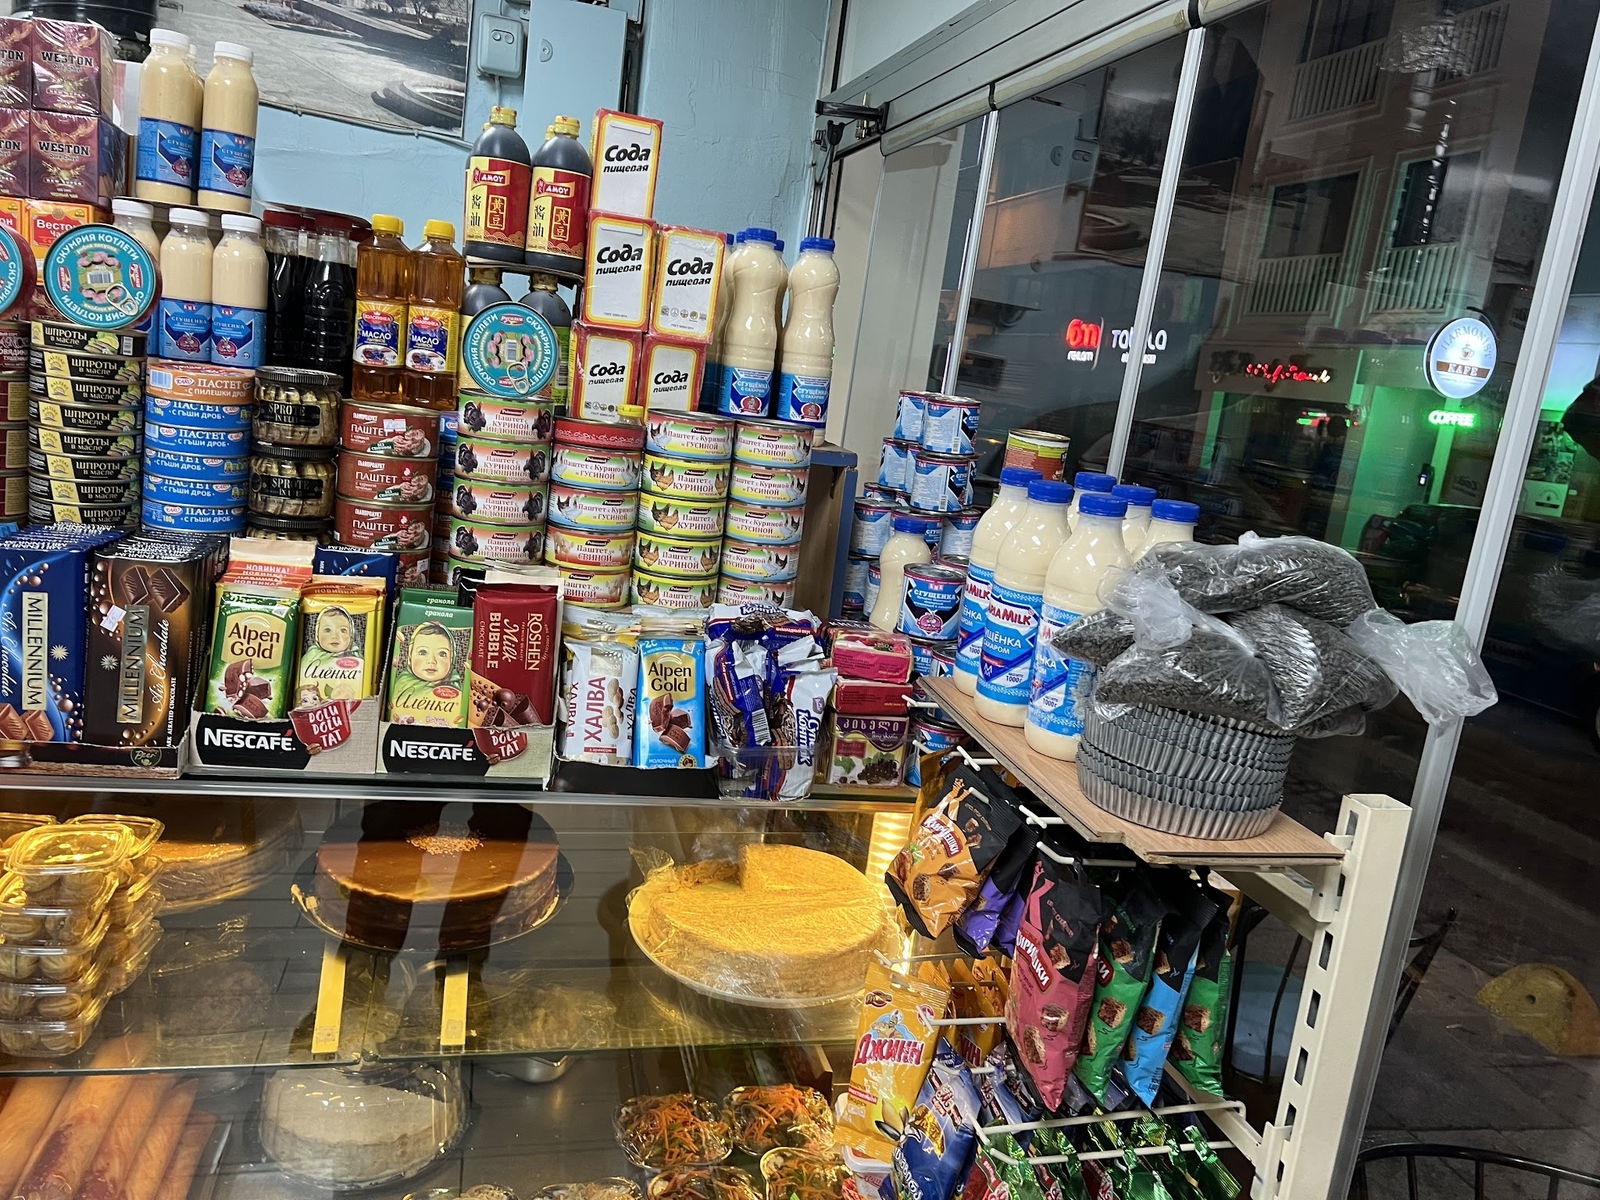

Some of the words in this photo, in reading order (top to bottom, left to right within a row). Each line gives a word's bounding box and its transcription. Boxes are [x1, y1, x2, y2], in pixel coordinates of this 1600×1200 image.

[41, 51, 94, 68] WESTON
[38, 140, 90, 157] WESTON
[604, 143, 652, 162] Сода
[603, 164, 650, 173] пищевая
[480, 173, 504, 184] AMOY
[545, 186, 570, 195] AMOY
[56, 234, 96, 265] СКУМРИЯ
[98, 234, 140, 261] КОТЛЕТИ
[596, 244, 644, 264] Сода
[595, 264, 643, 276] пищевая
[667, 257, 715, 277] Сода
[665, 278, 712, 288] пищевая
[60, 294, 103, 322] КОТЛЕТИ
[45, 327, 87, 341] ШПРОТЫ
[361, 330, 392, 341] МАСЛО
[472, 313, 499, 347] КОТЛЕТИ
[526, 316, 551, 354] СКУМРИЯ
[56, 337, 80, 345] масле
[411, 335, 440, 346] МАСЛО
[71, 358, 117, 370] ШПРОТЫ
[471, 350, 496, 386] СКУМРИЯ
[528, 354, 551, 387] КОТЛЕТ
[589, 362, 626, 377] Сода
[1447, 363, 1479, 377] KAFE
[85, 367, 112, 375] масле
[654, 370, 689, 385] Сода
[75, 383, 121, 395] ШПРОТЫ
[197, 378, 242, 390] ПАСТЕТ
[194, 389, 232, 398] ПИЛЕШКИ
[64, 409, 111, 421] ШПРОТЫ
[200, 412, 223, 420] ДРОБ
[268, 402, 306, 417] SPROTE
[78, 418, 104, 426] масле
[492, 420, 530, 429] КУРИНОЙ
[1429, 410, 1476, 427] COFFEE
[64, 435, 110, 446] ШПРОТЫ
[179, 429, 227, 440] ПАСТЕТ
[76, 461, 121, 473] ШПРОТЫ
[180, 462, 201, 471] ДРОБ
[483, 462, 521, 472] КУРИНОЙ
[355, 471, 398, 484] ПАШТЕТ
[579, 470, 616, 480] ГУСИНОЙ
[80, 486, 125, 497] ШПРОТЫ
[191, 489, 212, 497] ДРОБ
[673, 483, 715, 492] КУРИНОЙ
[83, 509, 126, 519] ШПРОТЫ
[482, 504, 520, 513] КУРИНОЙ
[212, 516, 232, 524] ДРОБ
[352, 519, 395, 533] ПАШТЕТ
[677, 521, 717, 532] КУРИНОЙ
[484, 545, 521, 554] КУРИНОЙ
[577, 545, 606, 554] Паштет
[657, 559, 699, 569] КУРИНОЙ
[564, 581, 591, 591] аштет
[968, 585, 991, 600] MILK
[658, 599, 700, 608] КУРИНОЙ
[424, 610, 454, 619] гранола
[1002, 610, 1032, 626] MILK
[227, 622, 281, 643] Alpen
[486, 612, 503, 670] BUBBLE
[501, 617, 521, 664] Milk
[523, 612, 544, 672] ROSHEN
[26, 597, 45, 706] MILLENNIUM
[146, 618, 170, 681] Chocolate
[230, 641, 273, 660] Gold
[122, 608, 147, 720] MILLENNIUM
[303, 658, 360, 682] Алёнка
[647, 660, 692, 680] Alpen
[651, 678, 688, 693] Gold
[169, 677, 177, 709] CHOCOLATE
[395, 686, 456, 714] Алёнка
[308, 707, 339, 724] DOLU
[583, 676, 606, 743] ХАЛВА
[312, 718, 343, 736] DOLU
[843, 719, 900, 732] კისელი
[318, 735, 343, 748] TAT
[498, 741, 521, 759] TAT
[854, 1034, 923, 1066] ДЖИНН
